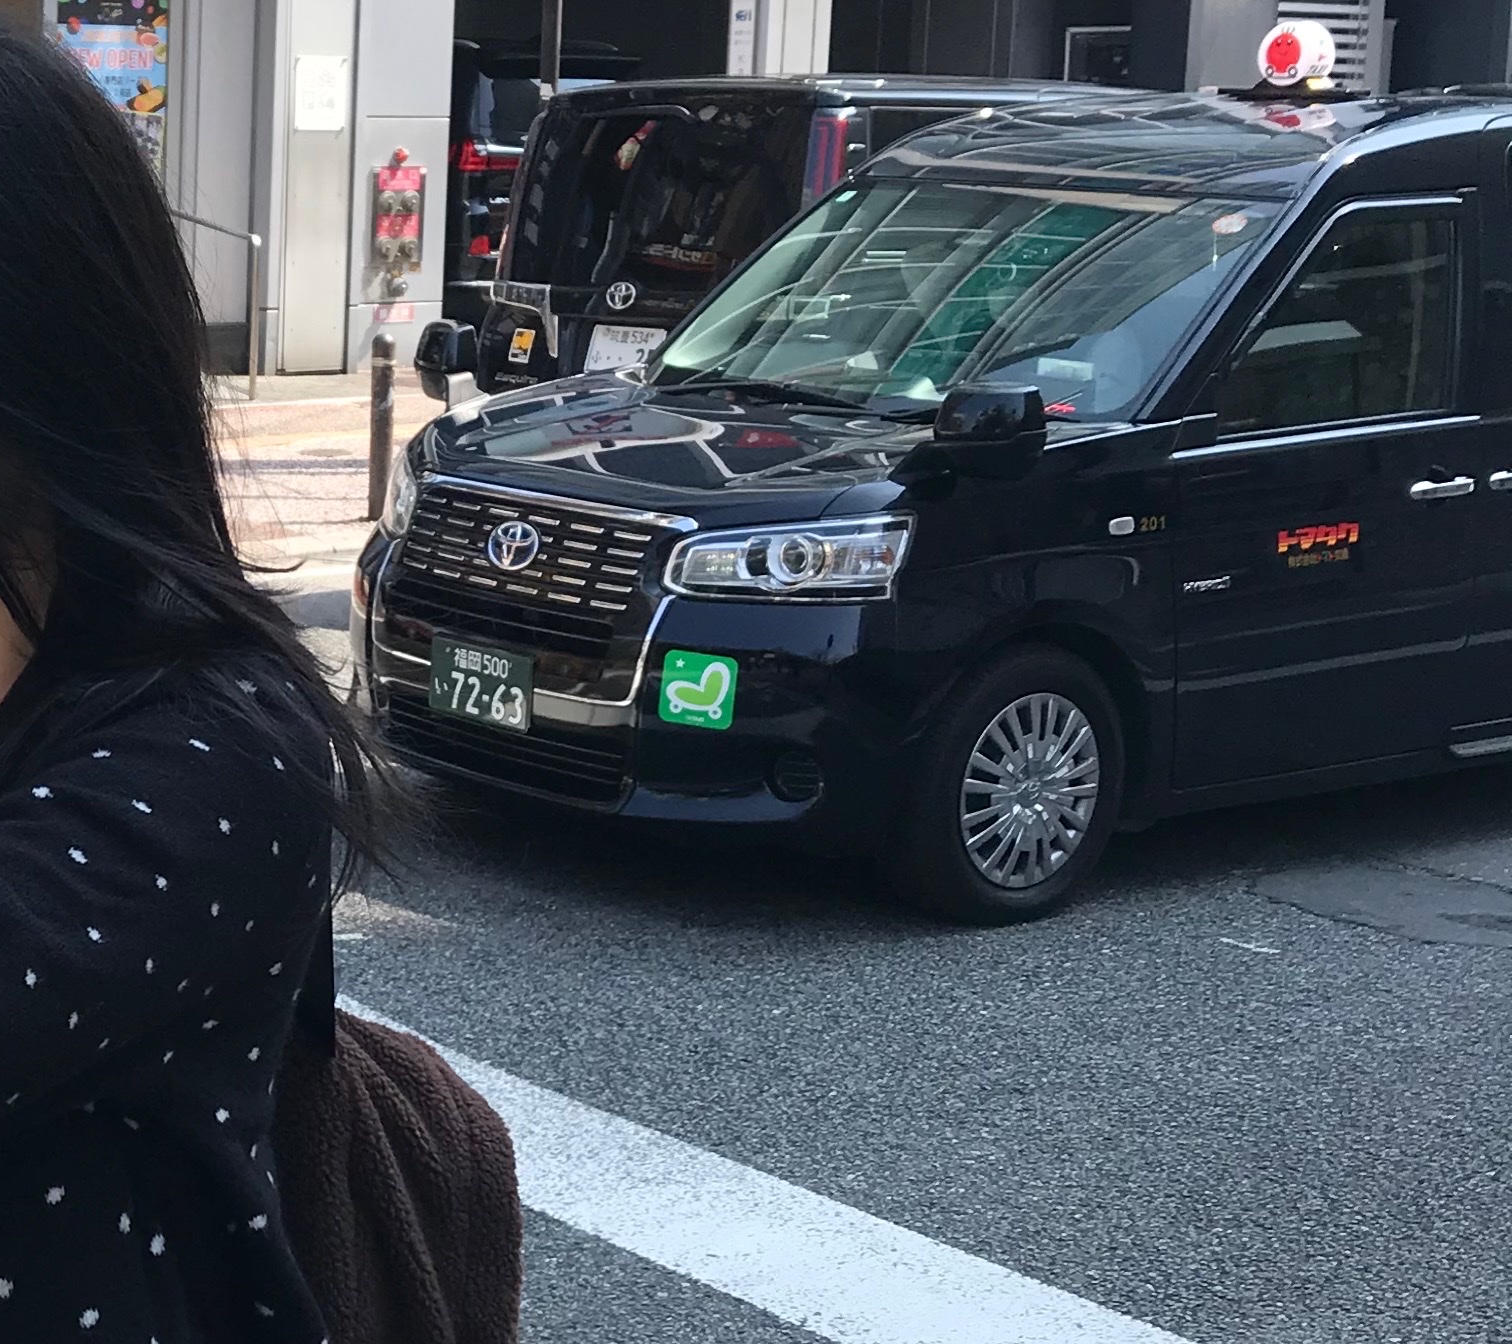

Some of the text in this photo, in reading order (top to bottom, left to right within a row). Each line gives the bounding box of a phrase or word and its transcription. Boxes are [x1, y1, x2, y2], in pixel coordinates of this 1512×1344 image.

[106, 47, 154, 70] OPEN!
[1140, 515, 1167, 532] 201
[1278, 522, 1360, 553] トマタク
[434, 671, 524, 724] い 72-63
